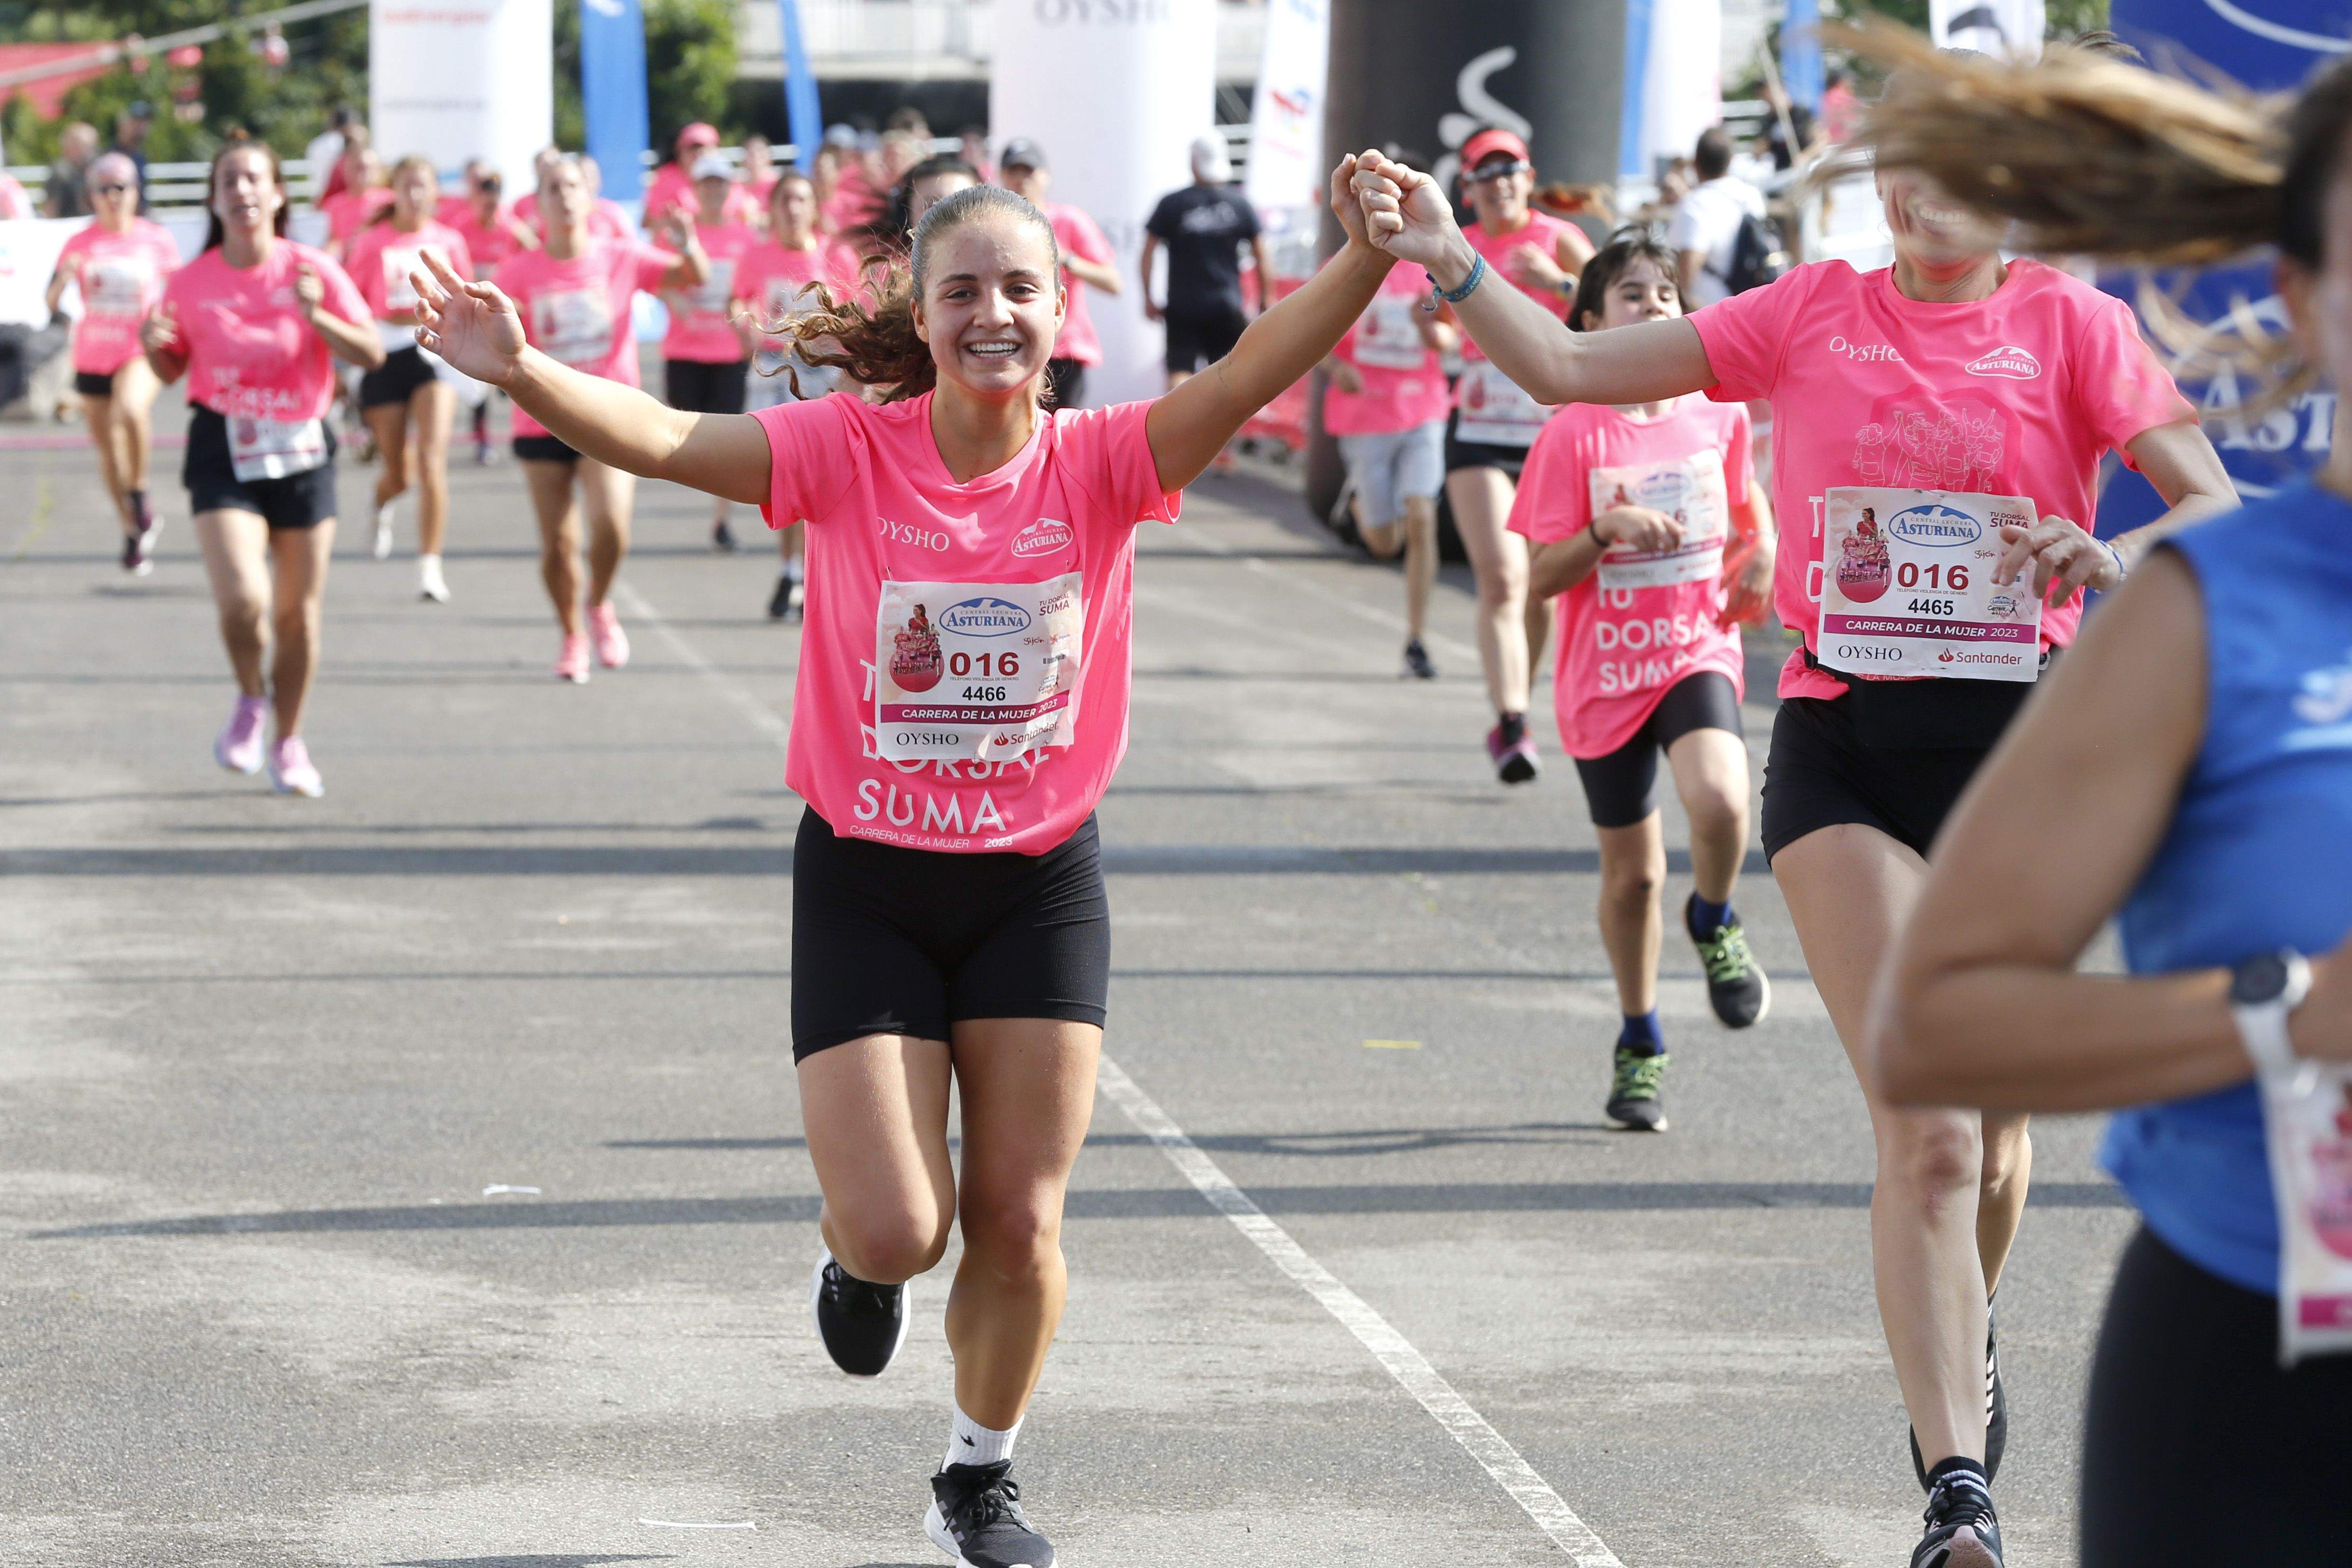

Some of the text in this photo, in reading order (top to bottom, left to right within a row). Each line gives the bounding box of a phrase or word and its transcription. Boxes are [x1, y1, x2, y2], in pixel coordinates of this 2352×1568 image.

[1466, 269, 1483, 293] CAMINO
[1971, 360, 2035, 375] ASTURIANA
[1808, 496, 1824, 538] T
[2001, 513, 2029, 521] DORSAL
[1895, 518, 1974, 538] ASTURIANA
[1015, 532, 1069, 552] ASTURIANA
[1897, 562, 1969, 590] 016
[1039, 600, 1069, 616] SUMA
[1048, 593, 1070, 604] DORSAL
[1908, 598, 1954, 615] 4465
[946, 612, 1024, 627] ASTURIANA
[1597, 609, 1712, 650] DORSA
[1846, 620, 2019, 638] CARRERA DE LA MUJER 2023
[1838, 645, 1903, 662] OYSHO
[1956, 652, 2023, 665] Santander
[950, 652, 1020, 677] 016
[1599, 650, 1695, 692] SUMA
[859, 659, 878, 702] T
[962, 686, 1006, 702] 4466
[902, 698, 1058, 720] CARRERA DE LA MUJER 2023
[897, 732, 959, 746] OYSHO
[1010, 721, 1060, 745] Santander
[853, 778, 1007, 834] SUMA
[850, 825, 1013, 849] CARRERA DE LA MUJER 2023
